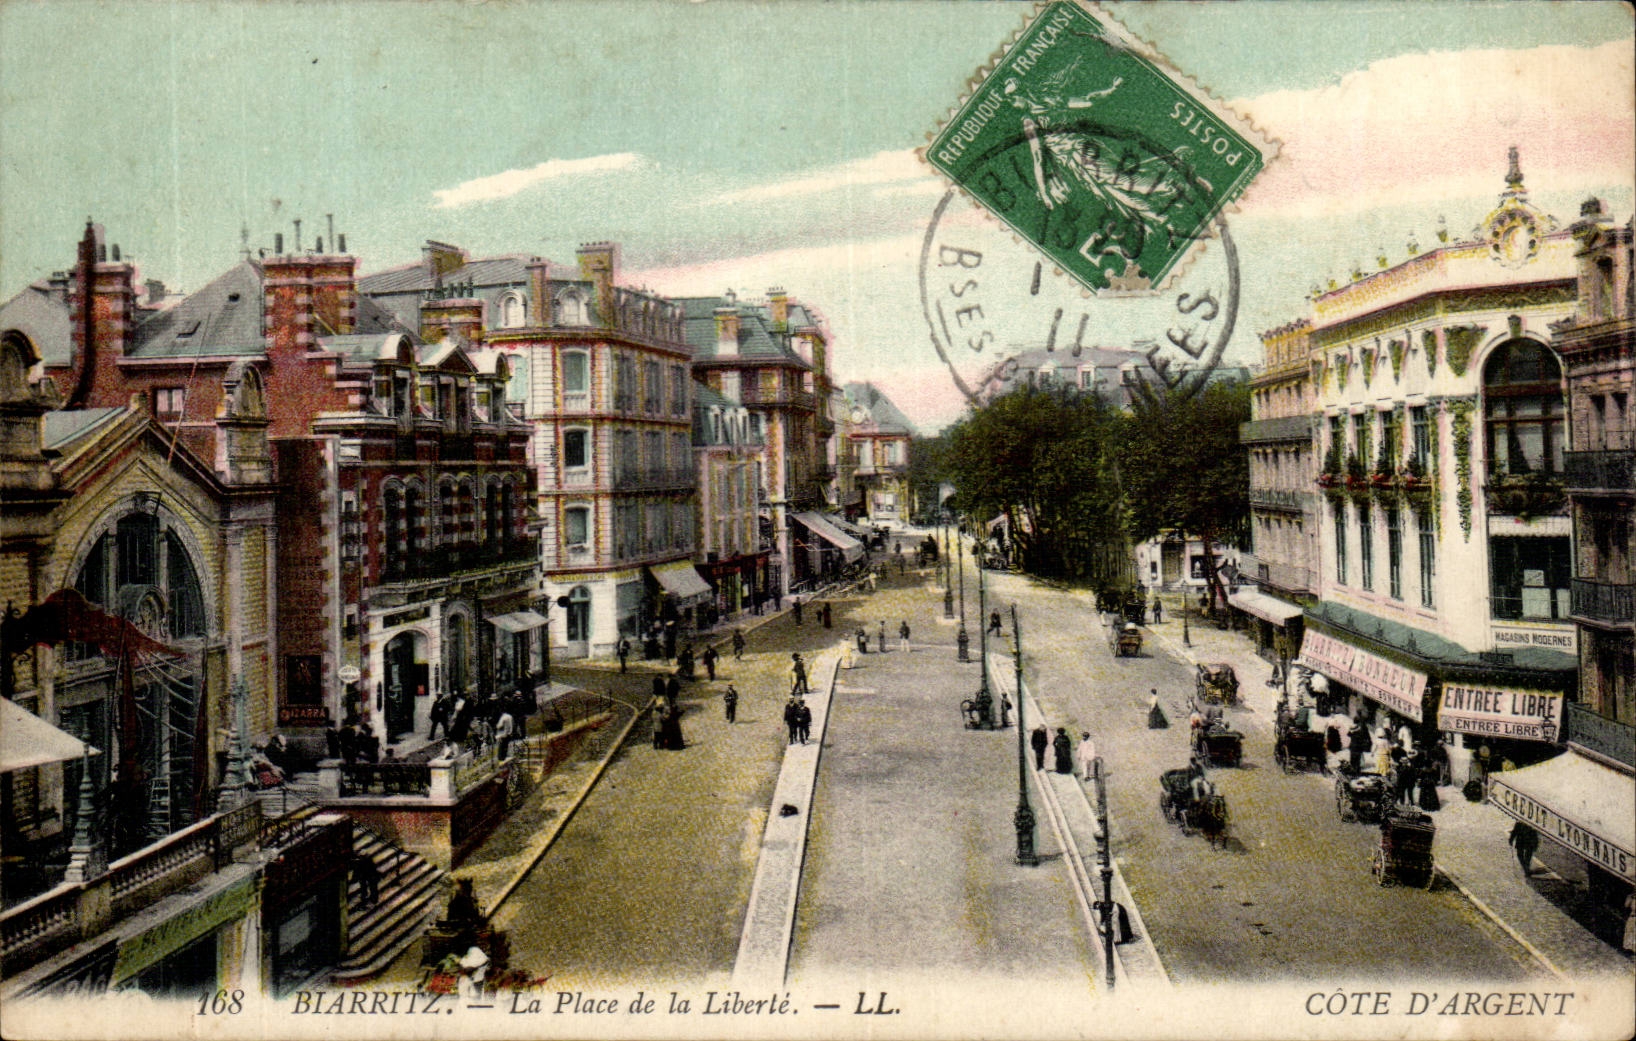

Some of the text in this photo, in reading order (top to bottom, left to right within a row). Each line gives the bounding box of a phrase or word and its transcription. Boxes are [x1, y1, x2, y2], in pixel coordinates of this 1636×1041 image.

[1011, 7, 1074, 76] FRANÇAISE
[1170, 102, 1242, 166] POSTES
[1495, 631, 1573, 648] MAGASINS MODERNES
[1511, 693, 1557, 719] LIBRE
[1504, 723, 1539, 737] LIBRE
[1558, 818, 1627, 873] LYONNAIS
